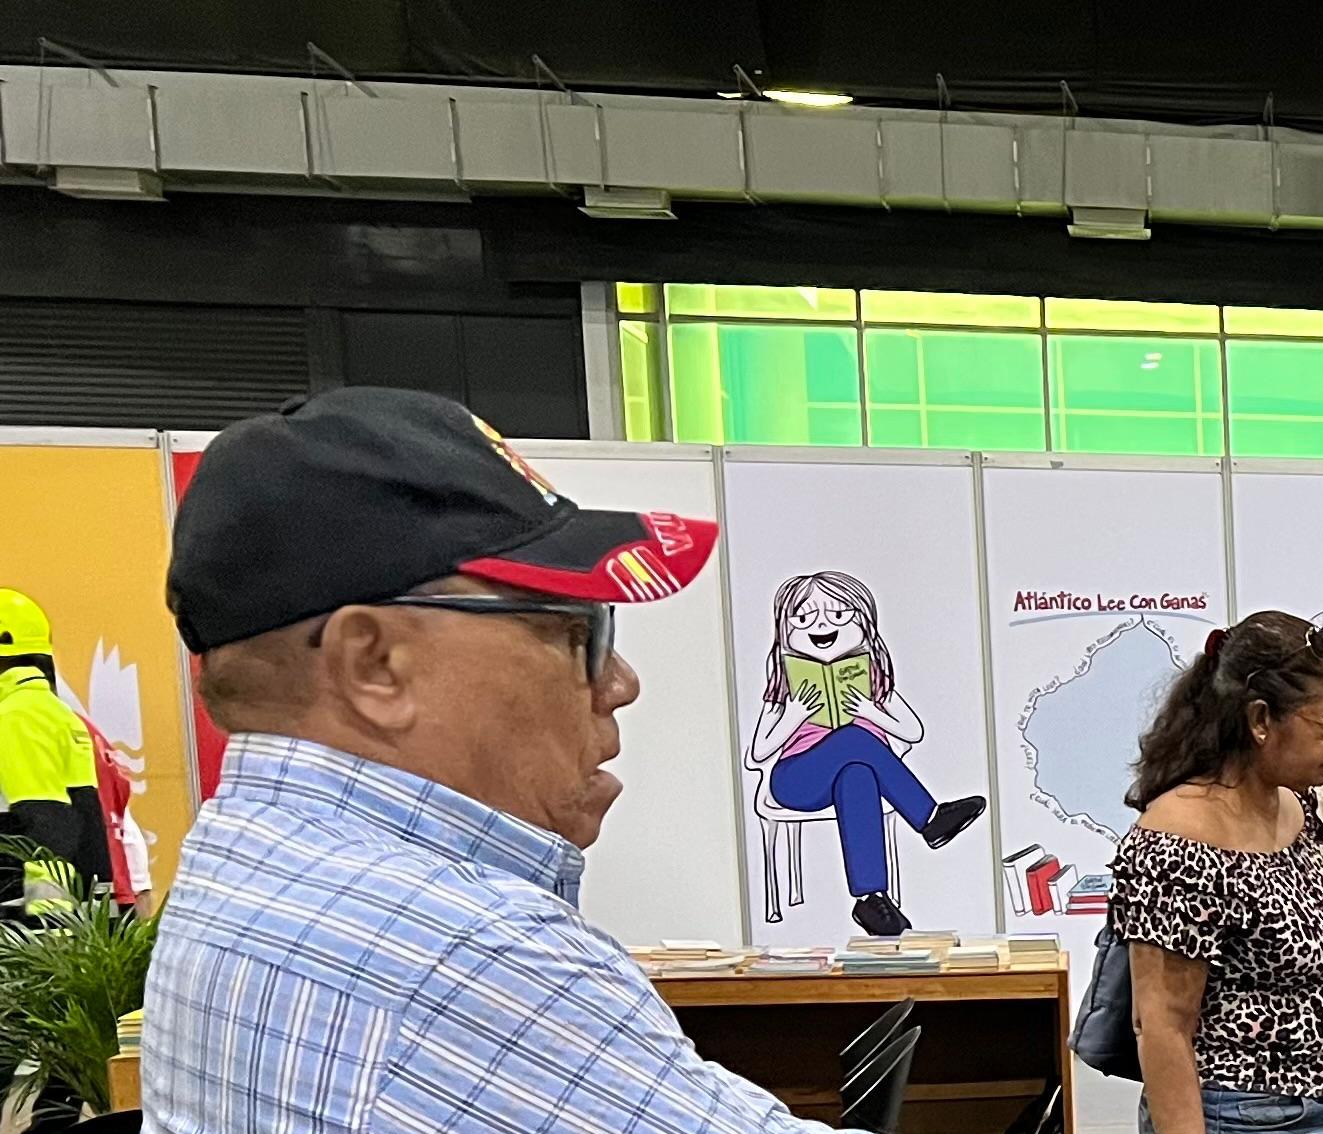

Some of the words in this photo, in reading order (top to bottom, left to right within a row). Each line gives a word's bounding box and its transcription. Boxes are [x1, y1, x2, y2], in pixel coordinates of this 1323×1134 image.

[1014, 590, 1092, 612] Atlántico
[1097, 593, 1126, 611] Lee
[1129, 594, 1157, 610] Con
[1160, 593, 1207, 610] Ganas
